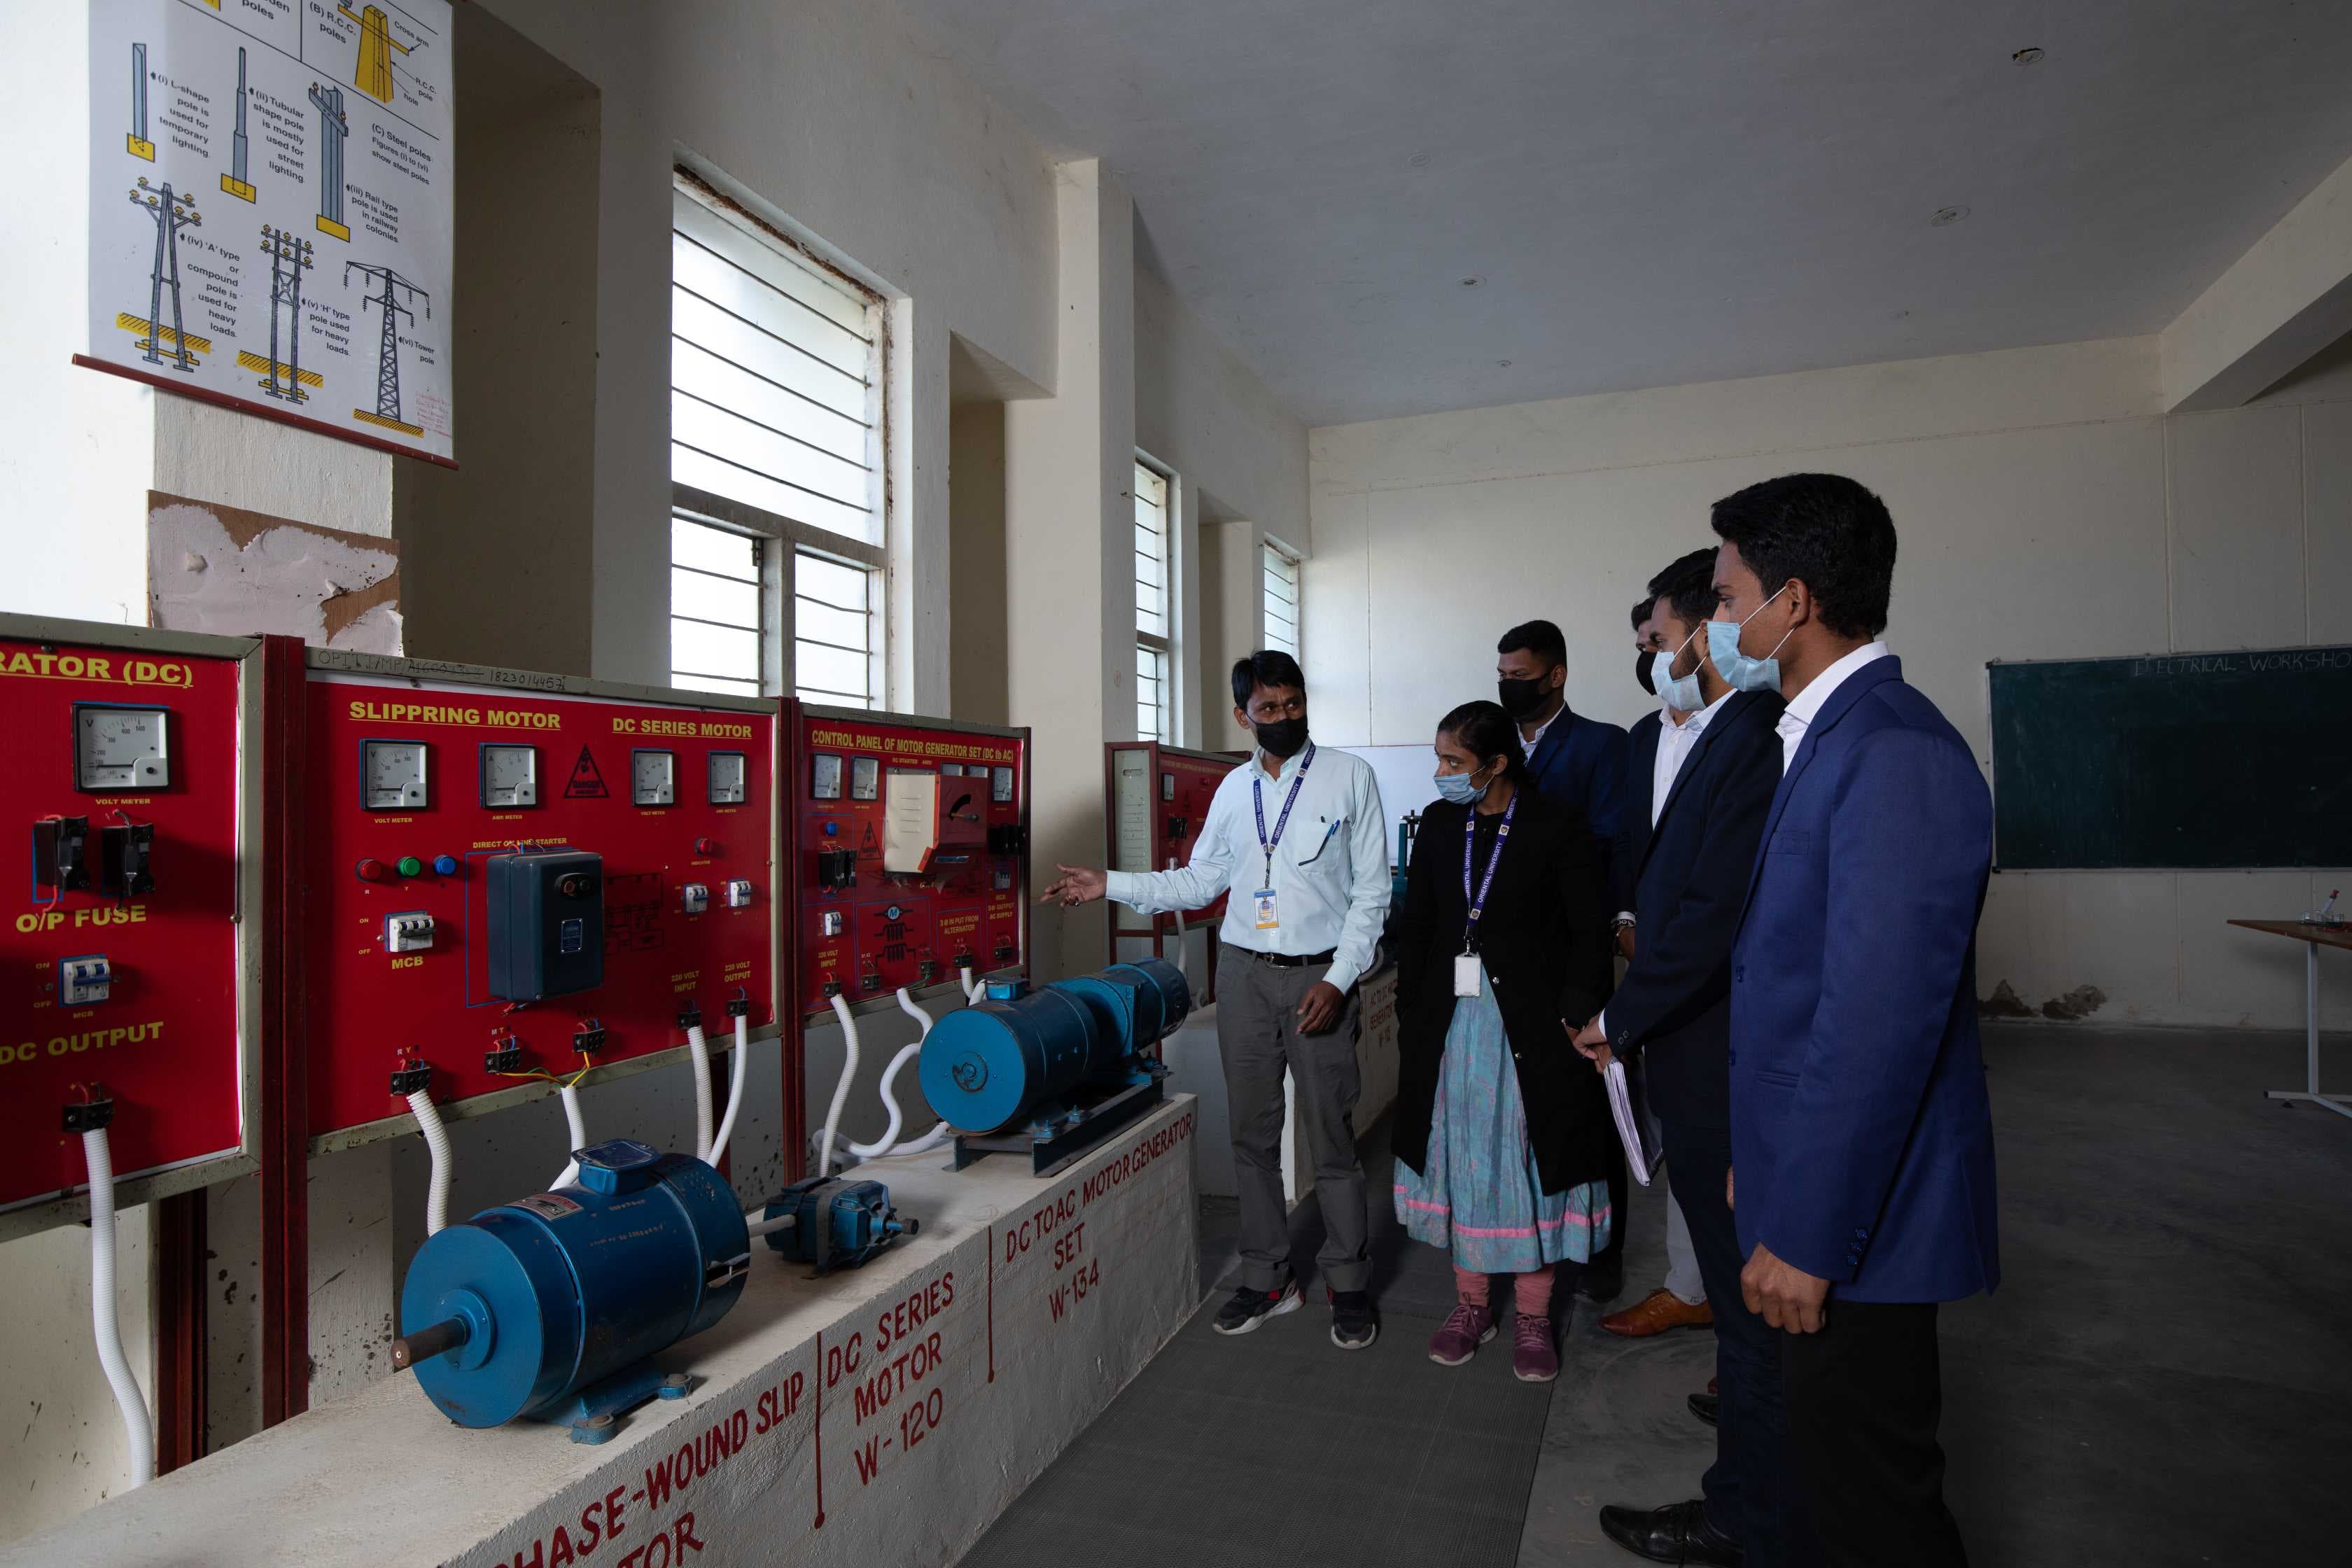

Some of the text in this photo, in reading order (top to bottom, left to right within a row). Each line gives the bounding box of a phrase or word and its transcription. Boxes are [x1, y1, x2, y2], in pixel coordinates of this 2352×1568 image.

[242, 0, 274, 20] poles
[309, 0, 324, 17] (B)
[327, 13, 356, 36] R.C.C.
[320, 23, 346, 43] poles
[395, 21, 429, 48] Cross arm
[158, 74, 209, 104] (i) L-shape
[404, 92, 419, 106] hole
[419, 90, 433, 102] pole
[178, 99, 209, 117] pole is
[256, 90, 304, 118] (ii) Tubular
[160, 116, 209, 144] temporary
[169, 108, 209, 130] used for
[253, 104, 304, 132] shape pole
[262, 119, 304, 146] is mostly
[372, 123, 384, 137] (C)
[386, 131, 407, 148] Steel
[267, 135, 304, 157] used for
[372, 136, 398, 156] Figures
[409, 157, 416, 165] to
[417, 162, 428, 173] (vi)
[278, 153, 304, 169] street
[372, 150, 429, 185] show steel poles
[350, 184, 398, 213] (iii) Rail type
[352, 197, 398, 223] pole is used
[363, 211, 398, 234] in railway
[188, 235, 203, 248] (iv)
[220, 248, 240, 261] type
[188, 263, 238, 287] compound
[230, 265, 239, 274] or
[198, 293, 237, 312] used for
[206, 284, 237, 300] pole is
[209, 309, 236, 326] heavy
[307, 300, 318, 311] (v)
[332, 309, 350, 321] type
[310, 314, 349, 332] pole used
[312, 326, 349, 345] for heavy
[402, 337, 435, 354] (vi) Tower
[420, 355, 435, 365] pole
[123, 661, 193, 686] (DC)
[86, 719, 94, 727] V
[349, 701, 561, 728] SLIPPRING MOTOR
[612, 718, 752, 738] DC SERIES MOTOR
[812, 730, 854, 746] CONTROL
[856, 735, 882, 750] PANEL
[885, 738, 895, 750] OF
[897, 738, 923, 753] MOTOR
[925, 743, 967, 757] GENERATOR
[969, 746, 980, 758] SET
[983, 748, 994, 760] (DC
[1003, 750, 1013, 762] AC)
[1274, 783, 1299, 839] ORIENTAL UNIVERSITY
[1478, 841, 1503, 904] ORIENTAL UNIVERSITY
[15, 905, 146, 933] O/P FUSE
[391, 955, 424, 969] MCB
[675, 981, 696, 993] INPUT
[724, 971, 750, 982] OUTPUT
[33, 1000, 52, 1009] OFF
[73, 1010, 94, 1019] MCB
[0, 1022, 164, 1065] DC OUTPUT
[1006, 1221, 1030, 1264] DC
[1082, 1153, 1130, 1208] MOTOR
[1132, 1112, 1193, 1173] GENERATOR
[1054, 1222, 1085, 1272] SET
[1049, 1257, 1099, 1324] W-134
[827, 1271, 955, 1389] DC SERIES
[854, 1331, 942, 1427] MOTOR
[855, 1387, 944, 1486] W-120
[493, 1371, 804, 1568] HASE-WOUND SLIP
